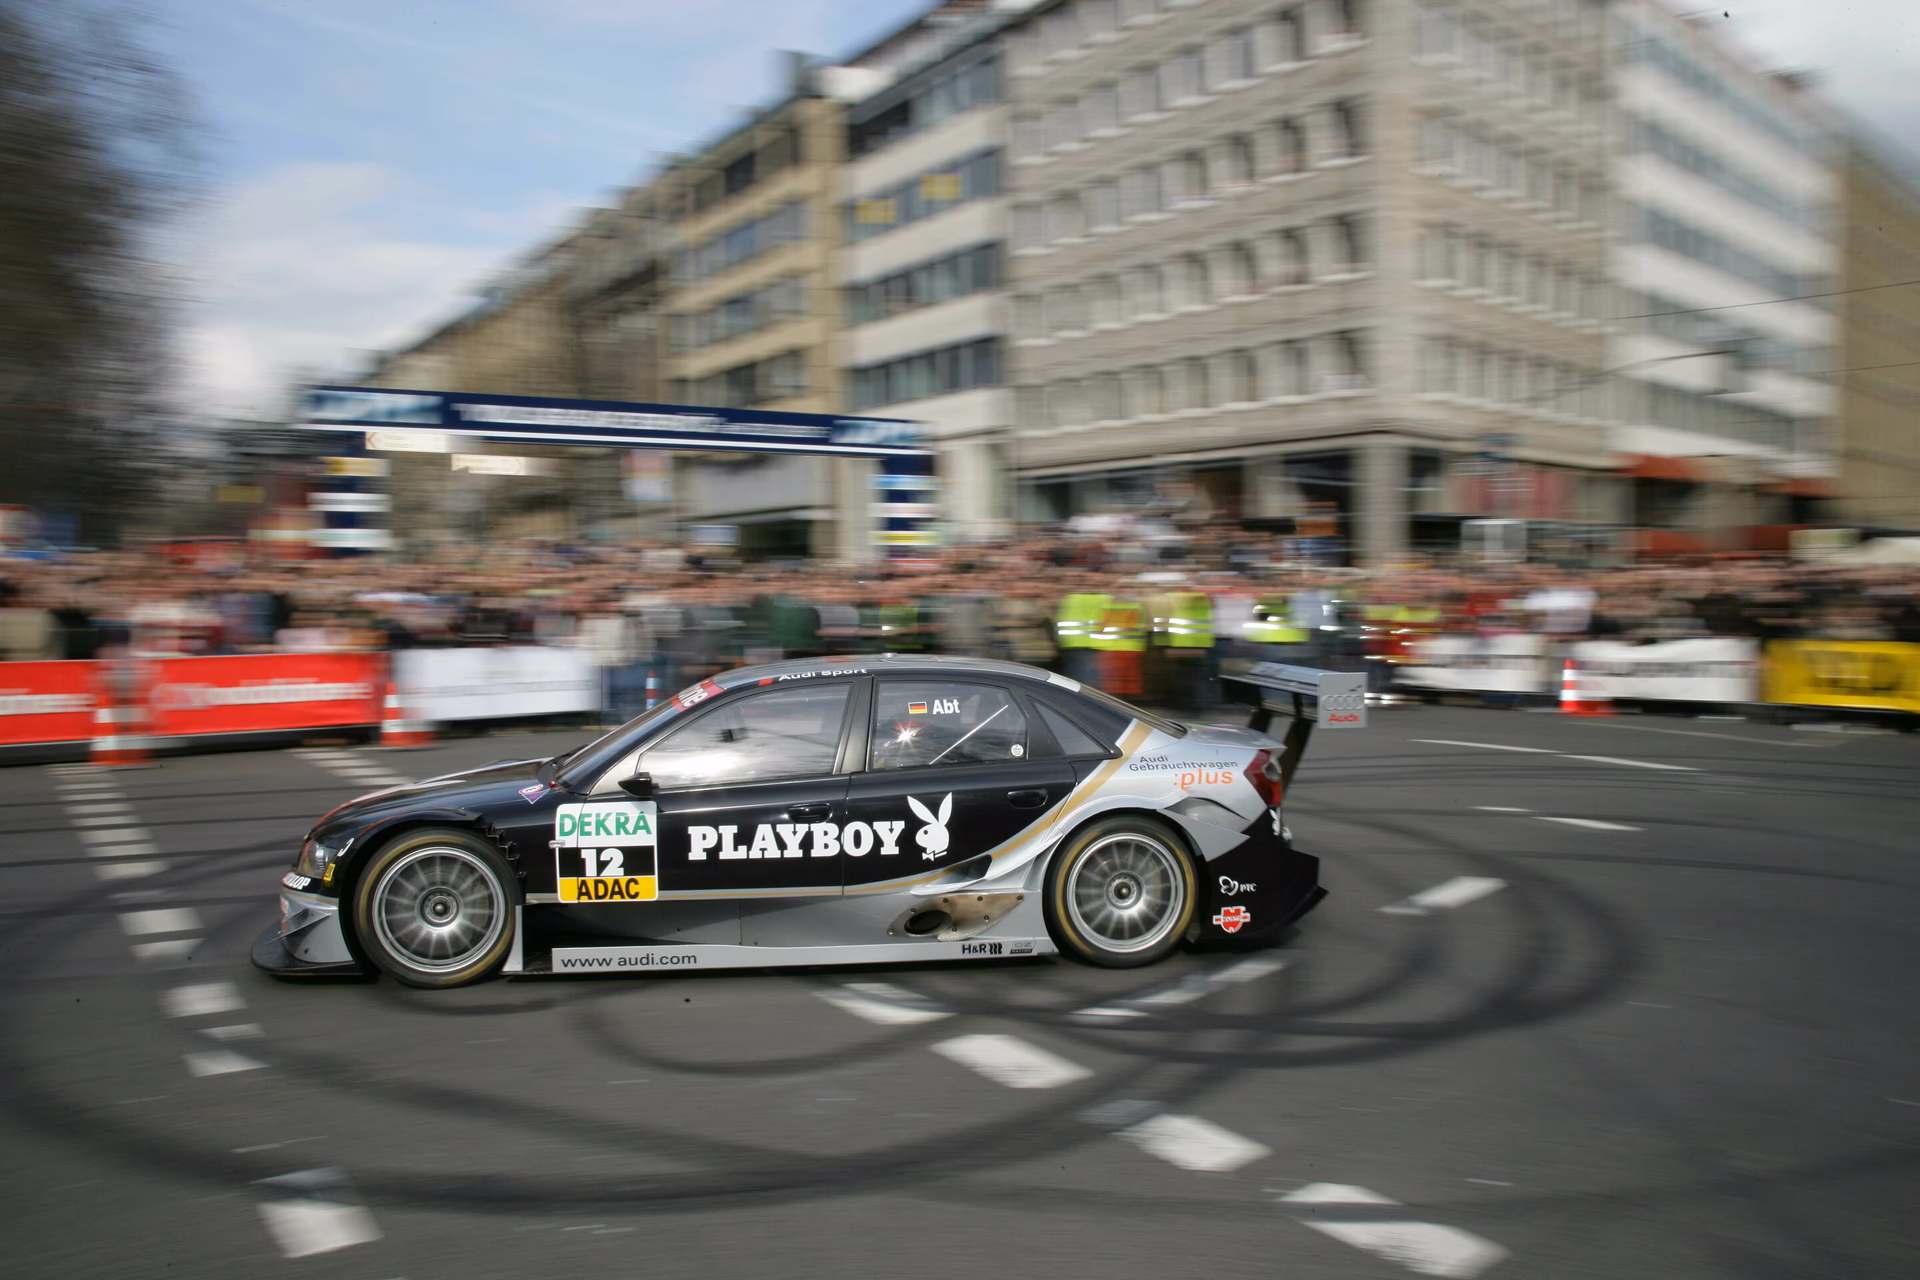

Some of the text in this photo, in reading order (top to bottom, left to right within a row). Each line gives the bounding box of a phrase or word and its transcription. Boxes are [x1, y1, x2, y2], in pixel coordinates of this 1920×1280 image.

[778, 668, 867, 682] Audi Sport
[932, 699, 960, 715] Abt
[1129, 761, 1239, 772] Gebrauchtwagen
[1139, 755, 1169, 763] Audi
[559, 811, 653, 837] DEKRA
[687, 821, 906, 861] PLAYBOY
[580, 848, 624, 877] 12
[576, 878, 640, 900] ADAC
[962, 943, 987, 955] H&R
